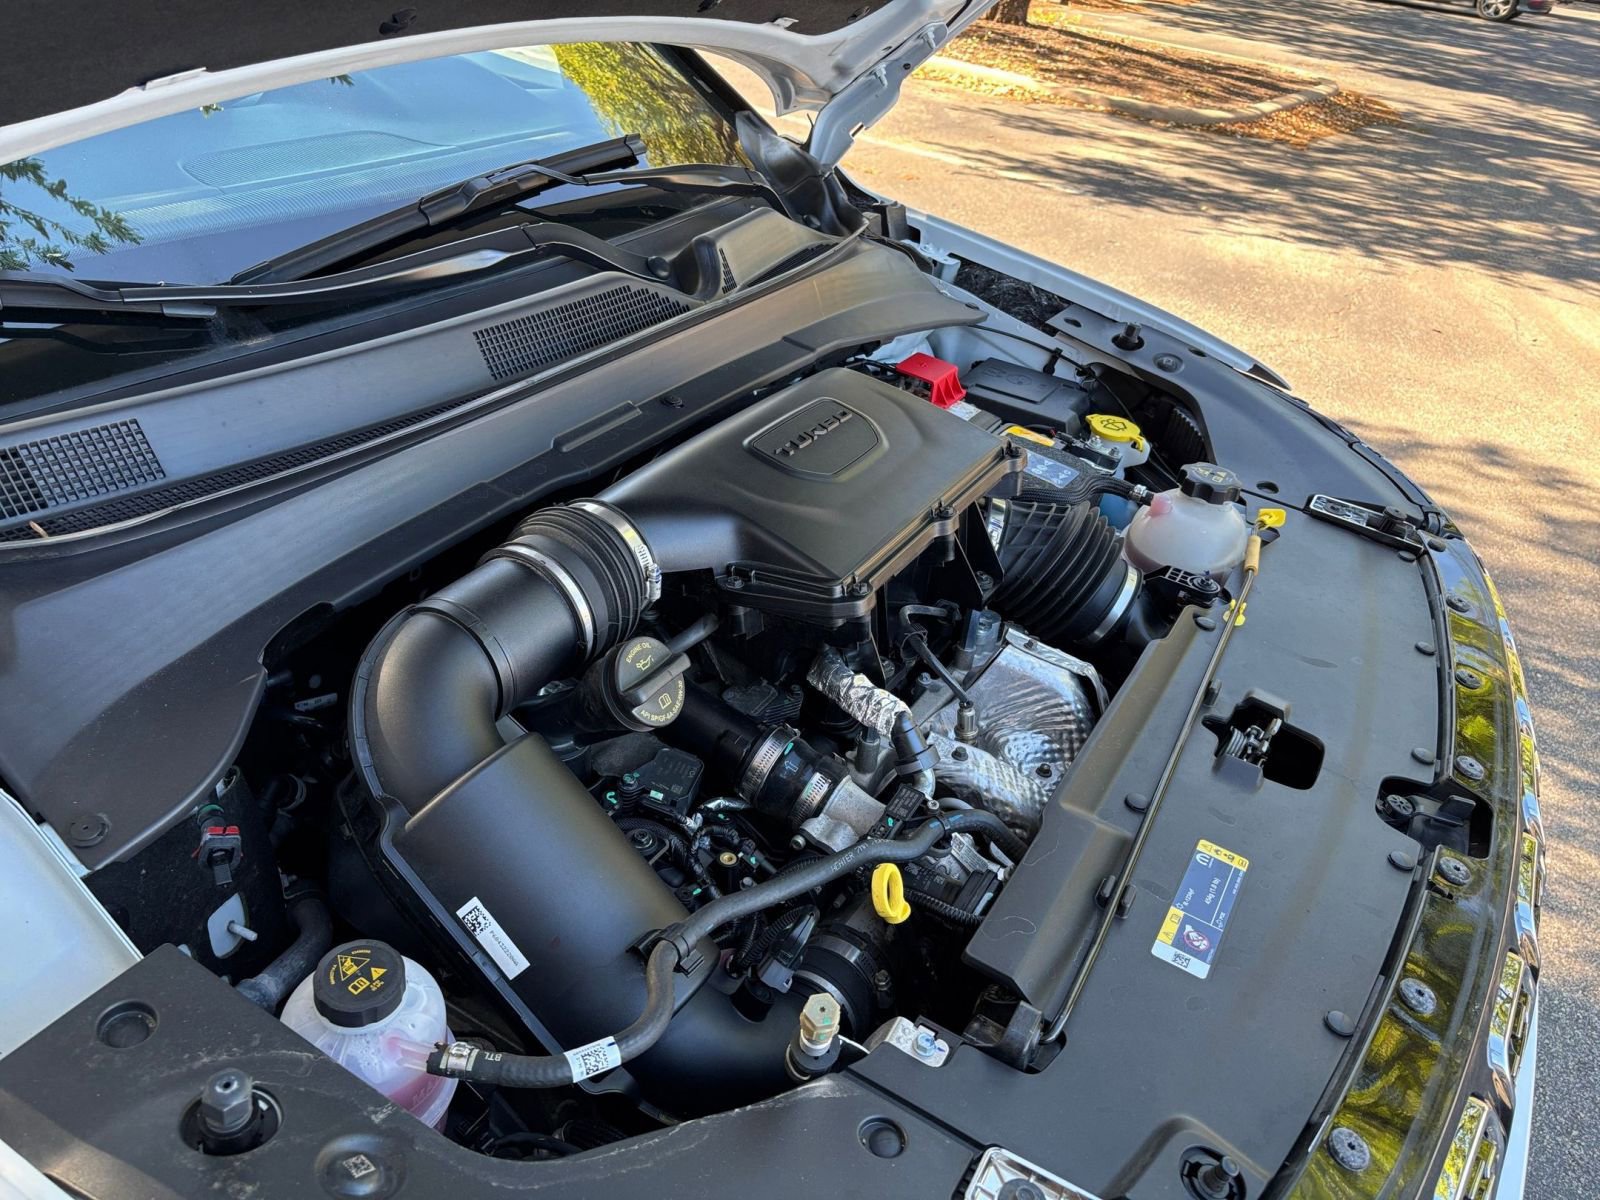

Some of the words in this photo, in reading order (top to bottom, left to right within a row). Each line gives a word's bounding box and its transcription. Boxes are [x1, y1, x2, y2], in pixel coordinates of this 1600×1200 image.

[773, 409, 853, 457] TURBO
[625, 645, 642, 664] ENGINE
[642, 641, 652, 649] OIL
[483, 1051, 502, 1062] BTL
